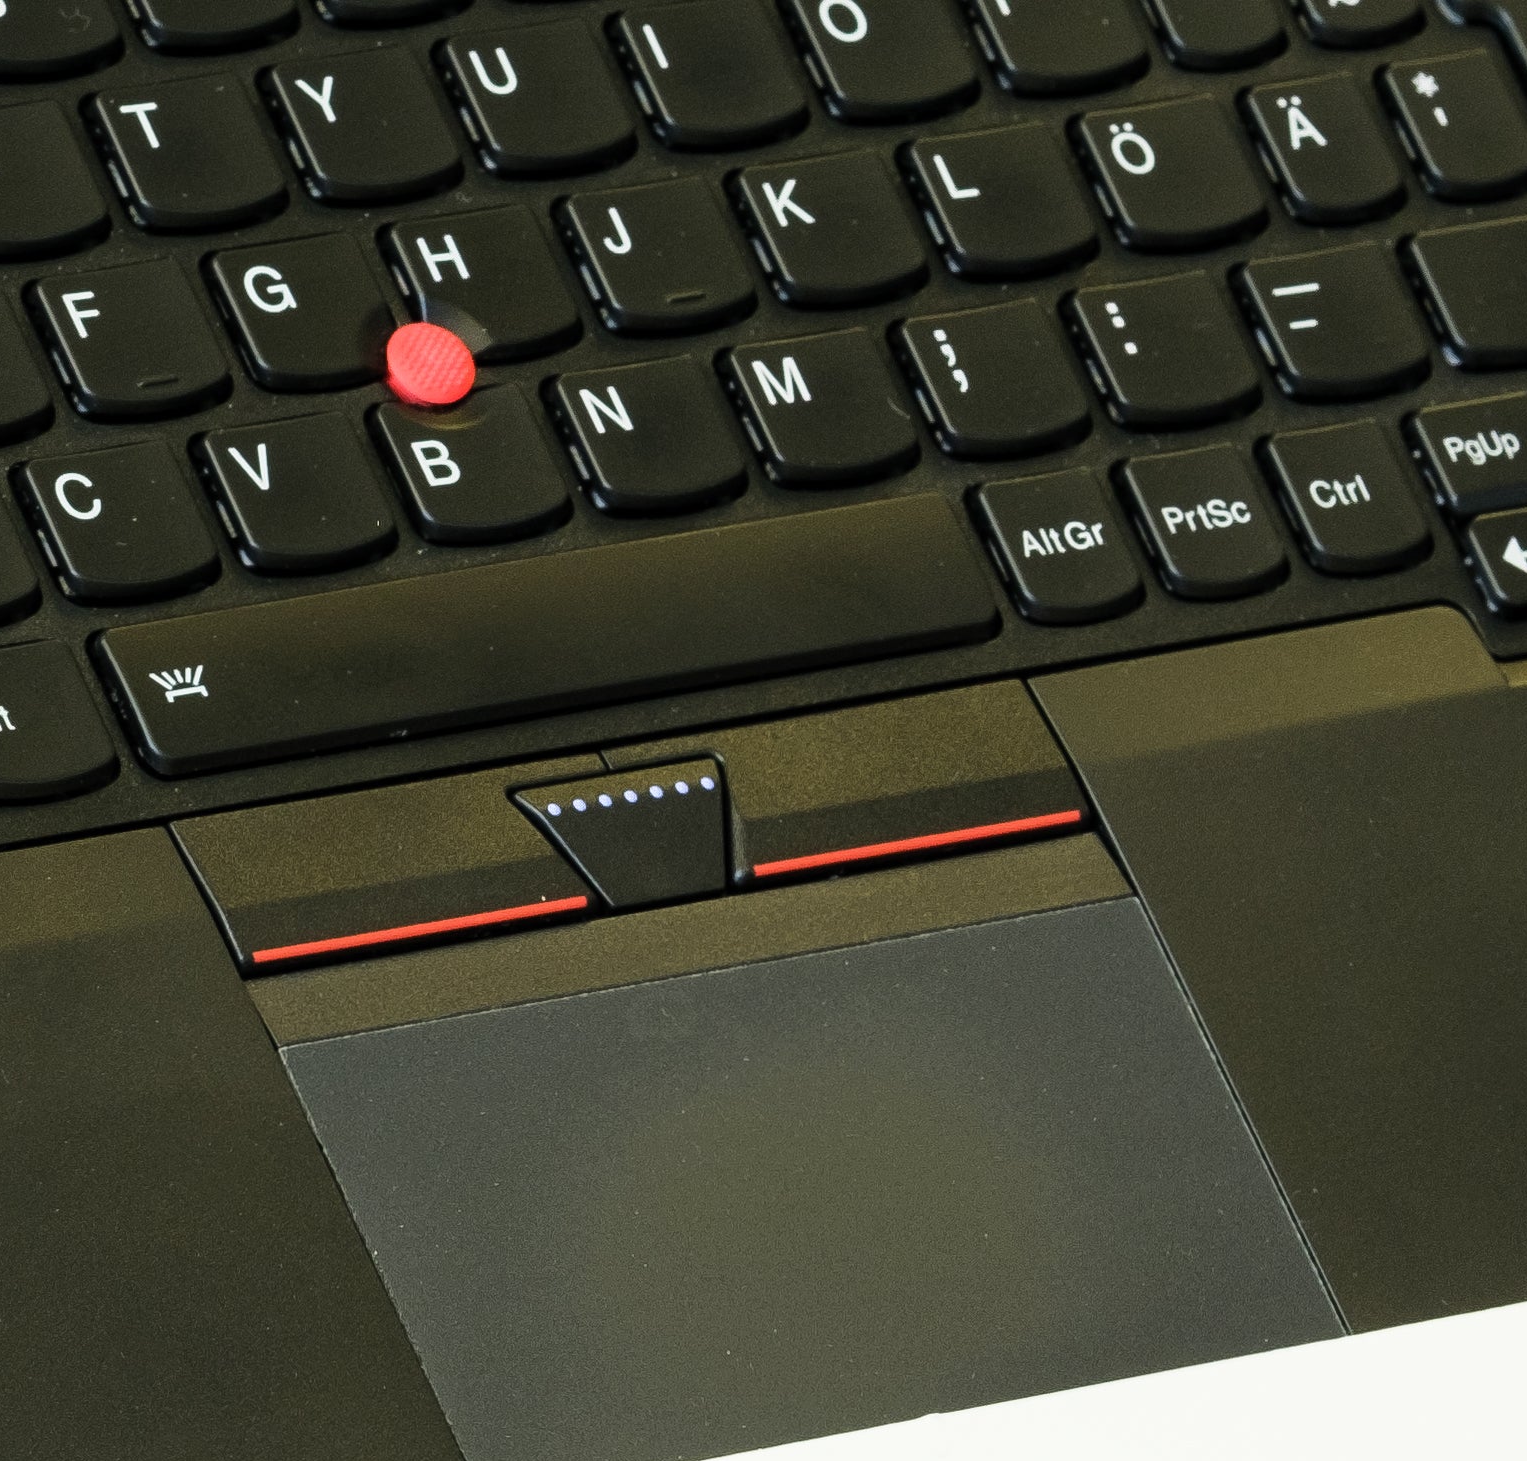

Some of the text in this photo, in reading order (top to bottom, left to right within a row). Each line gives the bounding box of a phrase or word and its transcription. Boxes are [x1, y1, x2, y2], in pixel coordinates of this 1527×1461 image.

[818, 0, 869, 43] O
[642, 24, 669, 69] I
[468, 47, 519, 95] U
[294, 75, 337, 123] Y
[1275, 95, 1327, 150] Ä
[119, 101, 160, 149] T
[1108, 122, 1157, 175] Ö
[932, 154, 982, 200] L
[761, 179, 816, 228] K
[603, 206, 633, 255] J
[416, 234, 471, 283] H
[243, 265, 298, 313] G
[61, 290, 101, 339] F
[751, 356, 812, 406] M
[578, 385, 635, 434] N
[227, 443, 271, 491] V
[410, 439, 461, 487] B
[1442, 430, 1522, 466] PgUp
[54, 472, 103, 520] C
[1308, 474, 1372, 509] Ctrl
[1161, 498, 1253, 536] PrtSc
